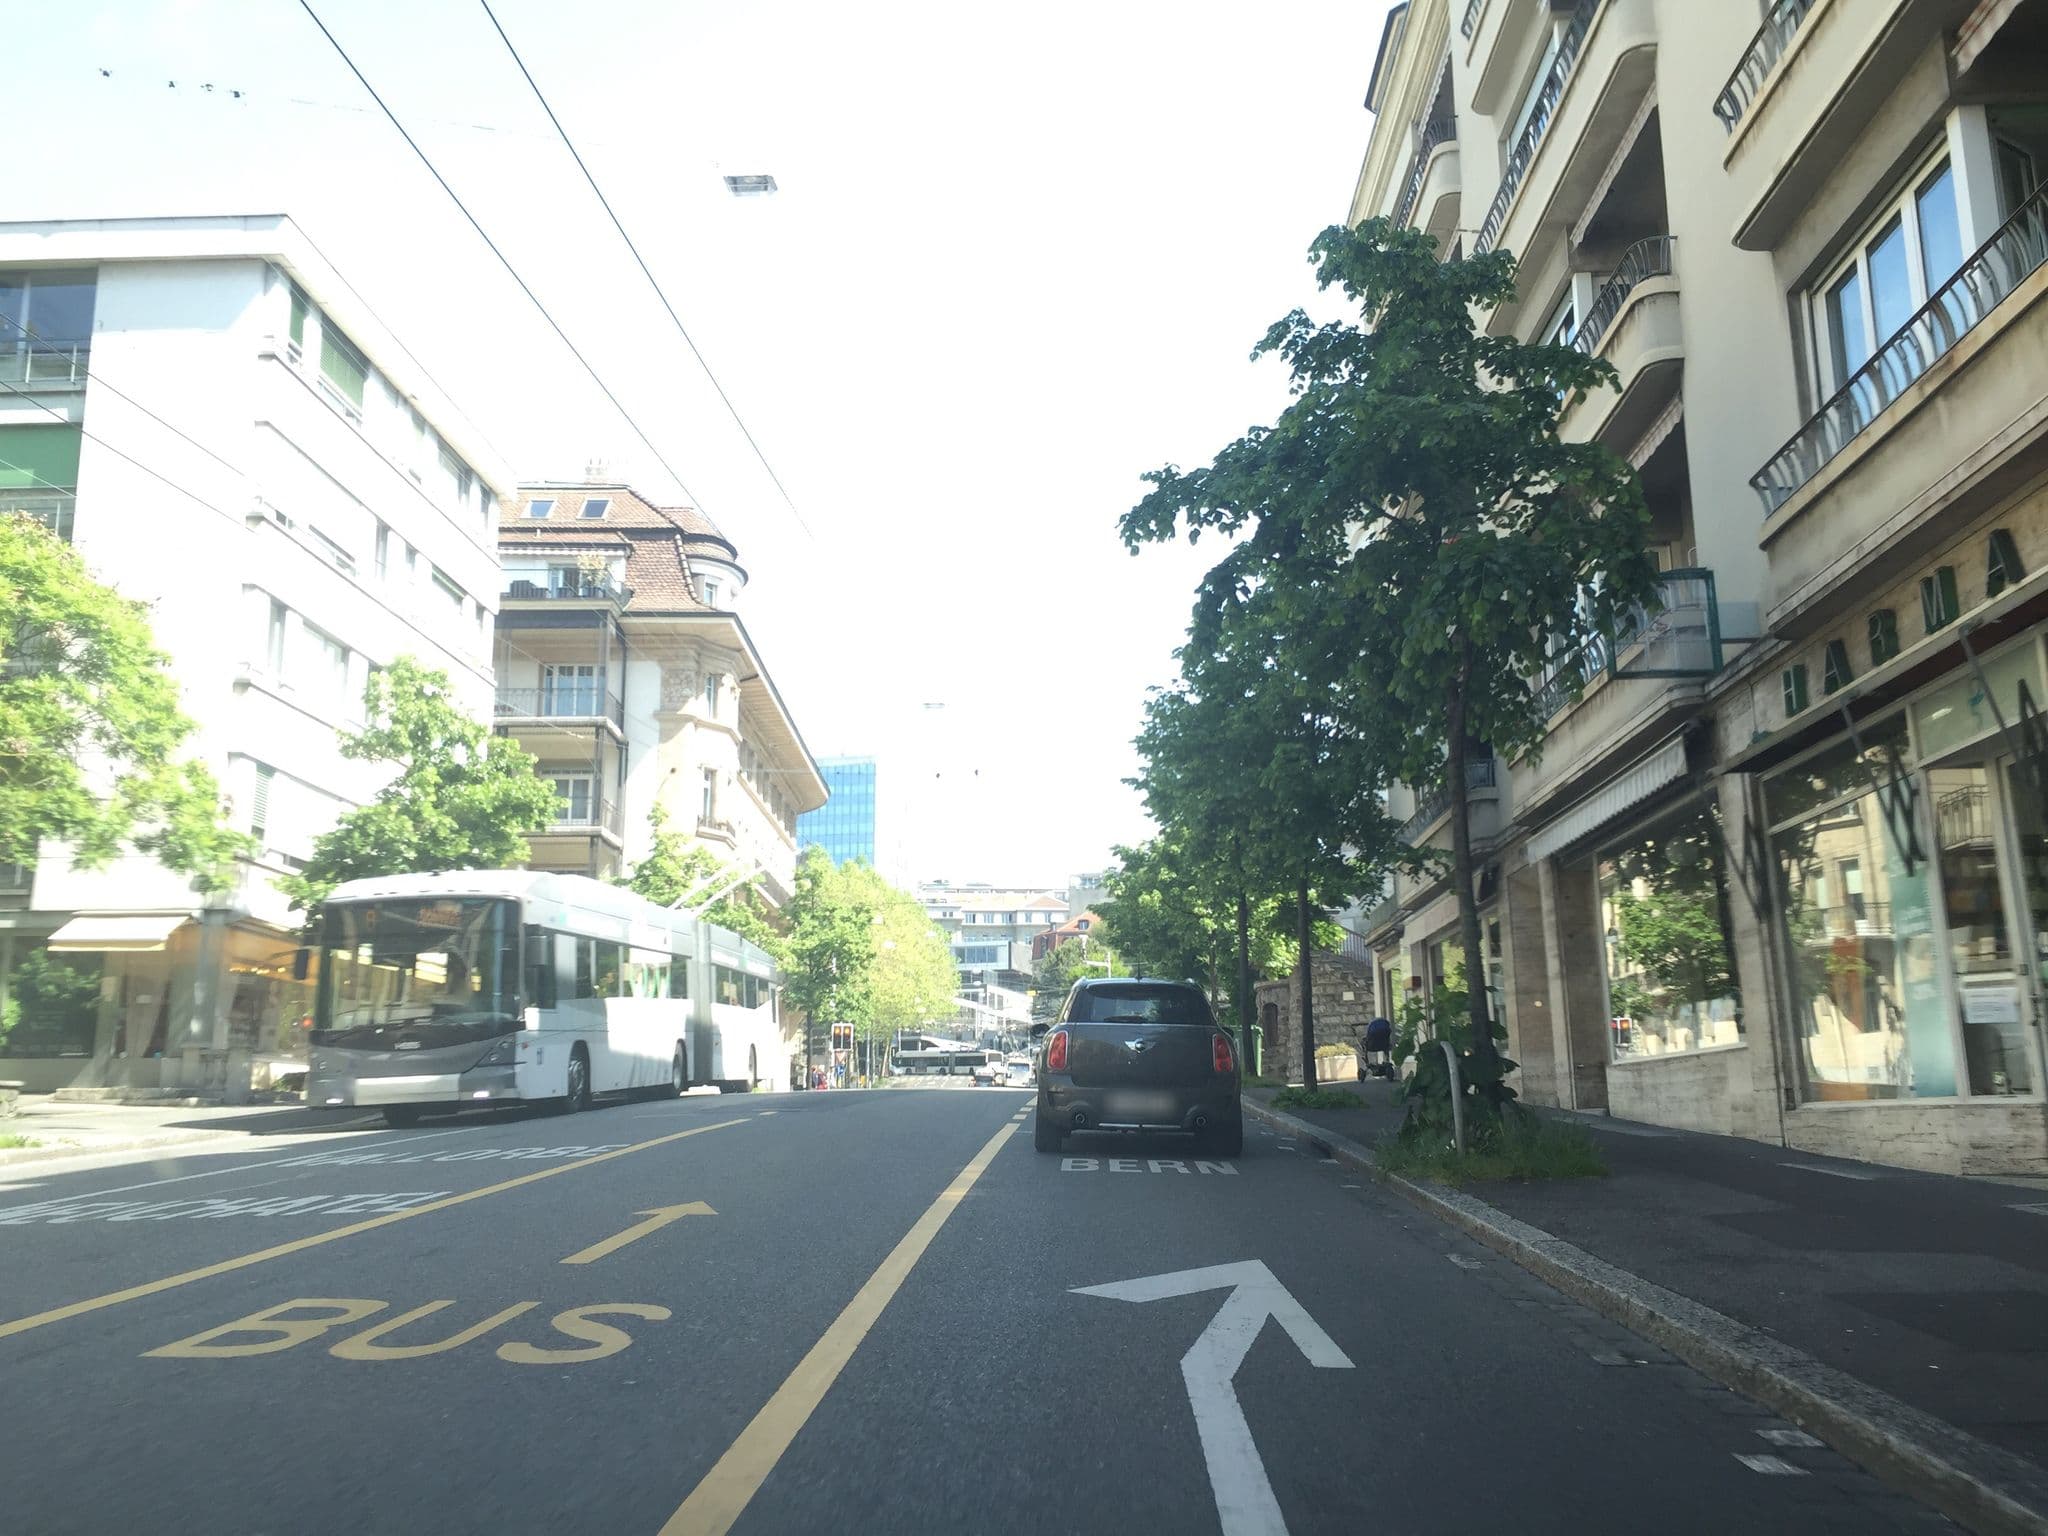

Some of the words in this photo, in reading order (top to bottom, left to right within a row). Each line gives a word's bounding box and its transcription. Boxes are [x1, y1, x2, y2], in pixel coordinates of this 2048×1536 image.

[277, 1144, 631, 1166] VALLORBE
[1061, 1158, 1239, 1174] BERN
[138, 1298, 673, 1364] BUS
